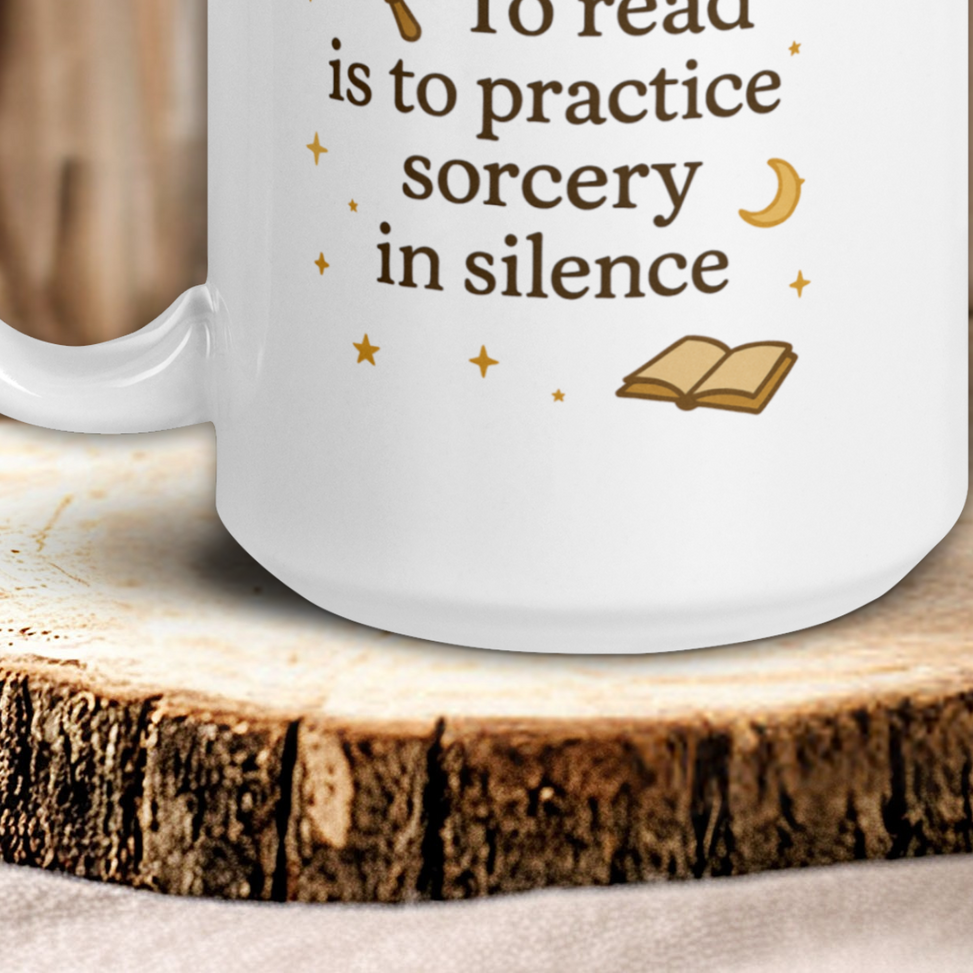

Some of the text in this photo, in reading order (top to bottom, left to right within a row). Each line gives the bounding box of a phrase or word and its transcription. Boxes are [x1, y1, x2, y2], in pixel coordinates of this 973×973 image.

[328, 37, 781, 142] is to practice
[402, 154, 703, 228] sorcery
[376, 221, 729, 300] in silence
